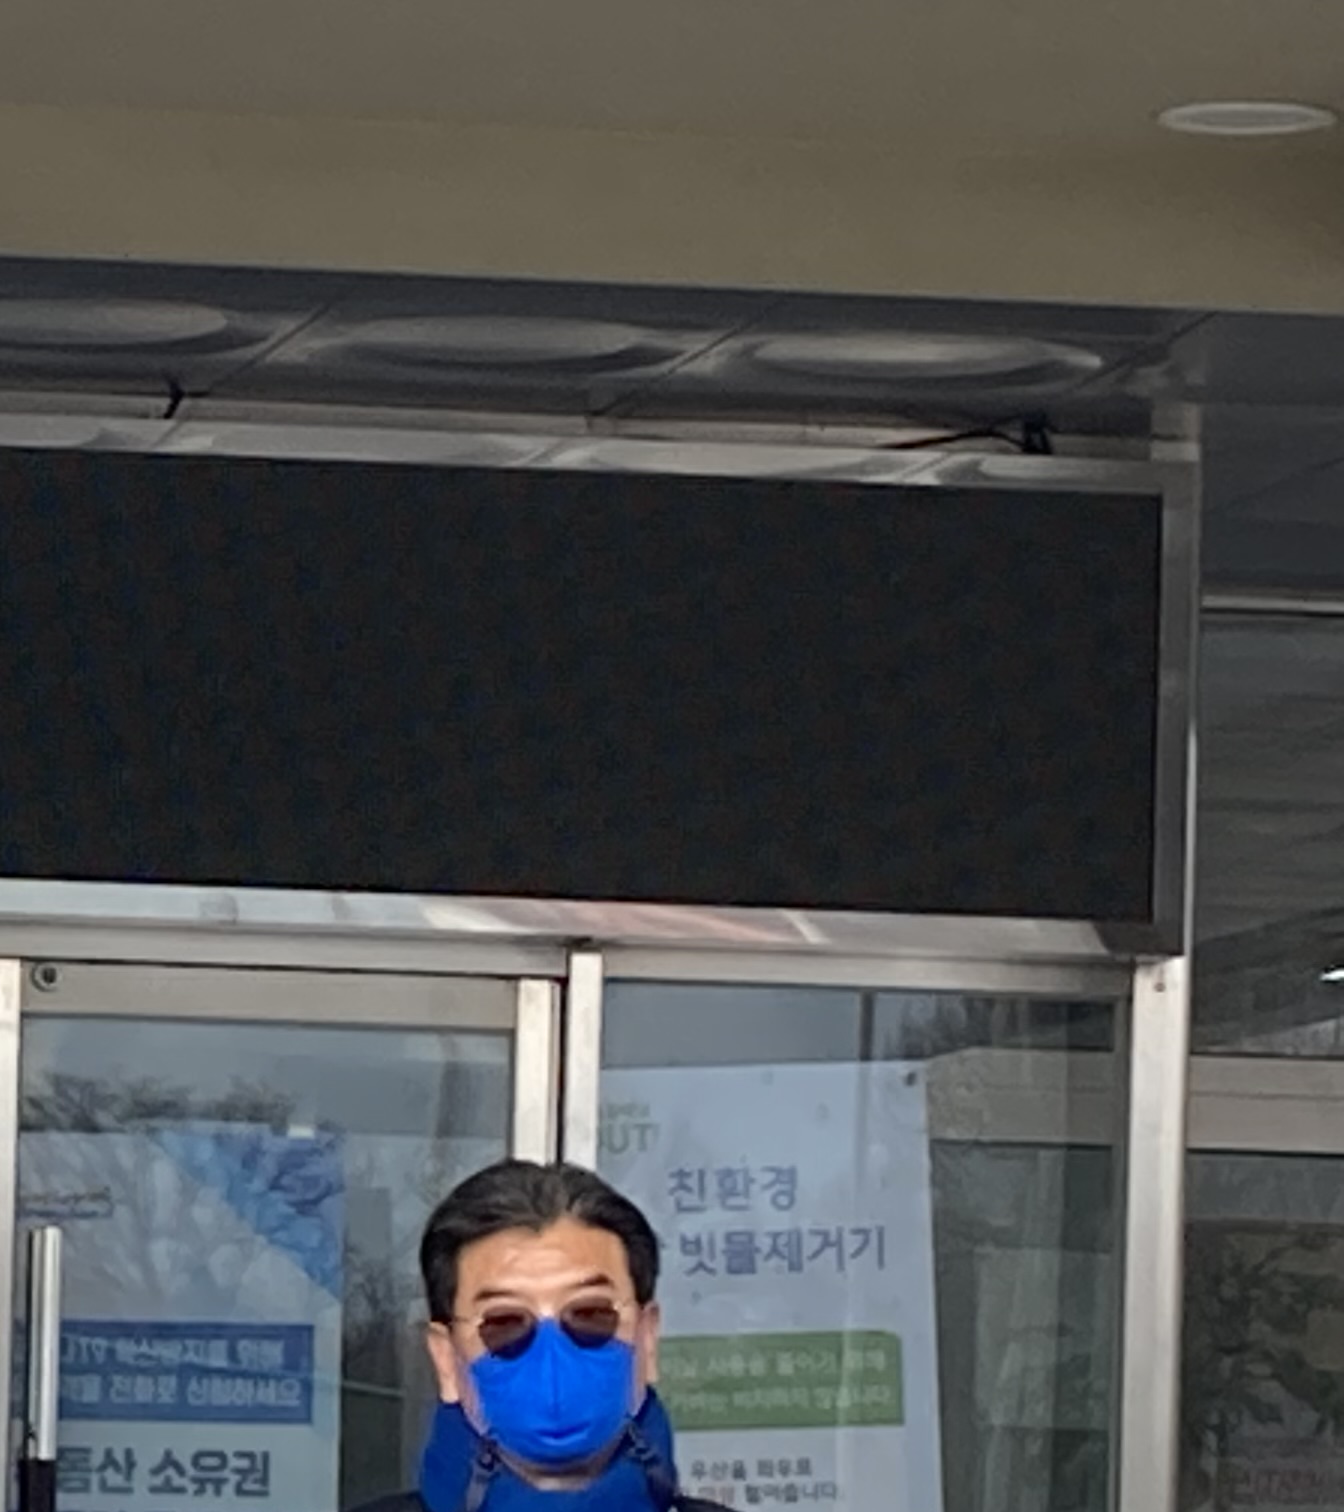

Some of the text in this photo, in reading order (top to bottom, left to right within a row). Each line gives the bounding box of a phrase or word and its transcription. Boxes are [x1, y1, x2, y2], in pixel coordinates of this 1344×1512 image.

[667, 1166, 799, 1211] 친환경
[679, 1226, 887, 1276] 빗물제거기
[148, 1448, 270, 1498] 소유권
